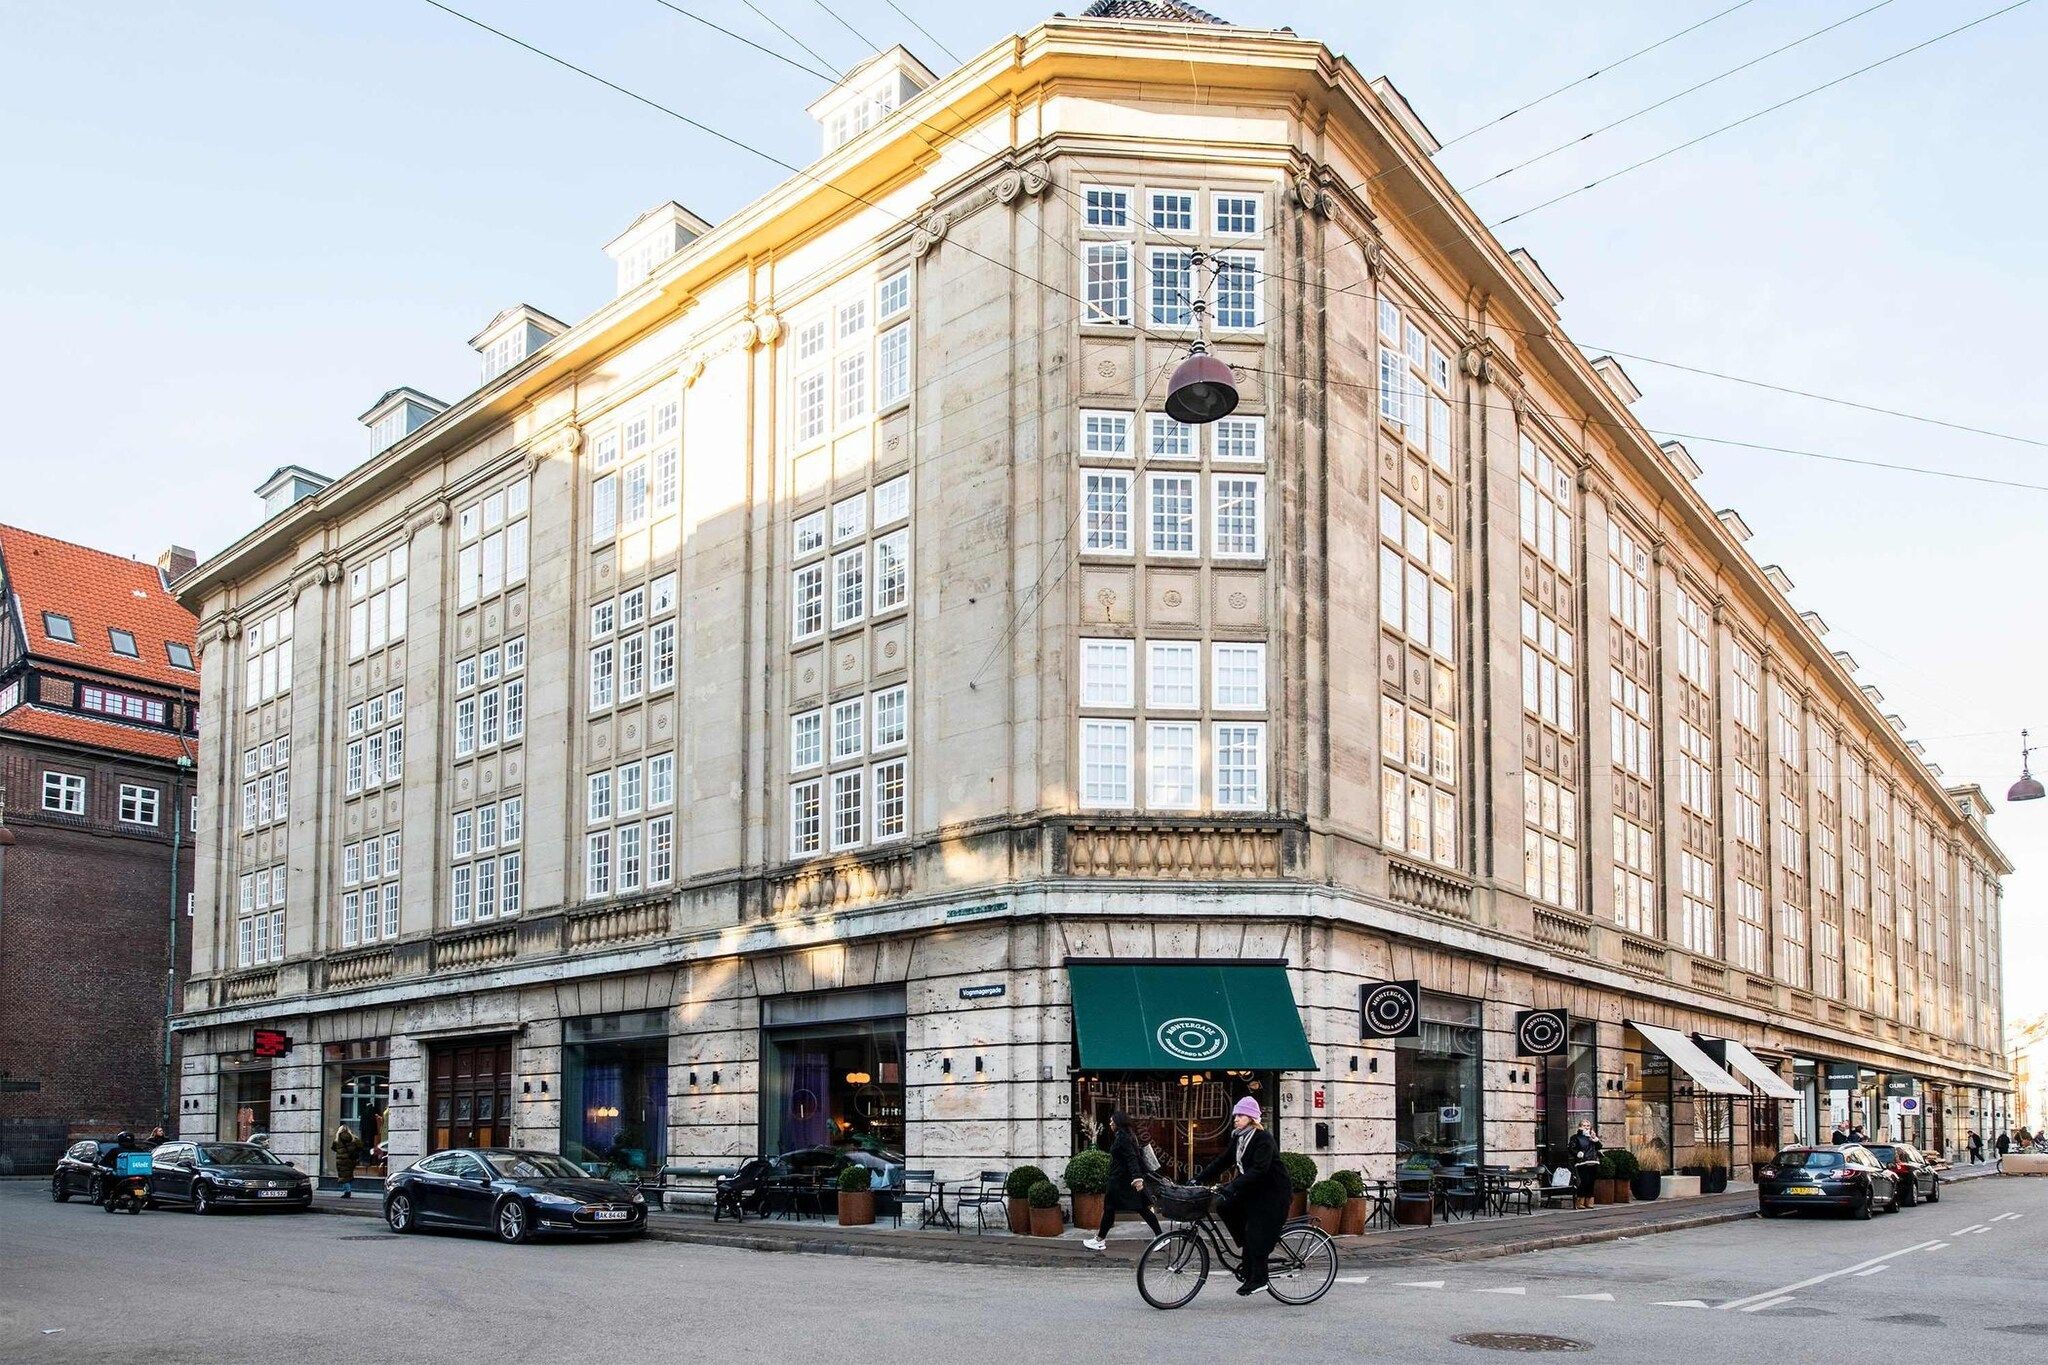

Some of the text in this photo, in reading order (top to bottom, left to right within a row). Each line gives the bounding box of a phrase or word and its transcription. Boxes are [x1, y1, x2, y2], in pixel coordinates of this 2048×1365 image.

[962, 987, 1002, 996] Vognmagergade
[1372, 991, 1407, 1006] MØNTERGADE
[1166, 1023, 1216, 1035] MØNTERGADE
[1057, 1095, 1069, 1104] 19
[1281, 1093, 1293, 1102] 19
